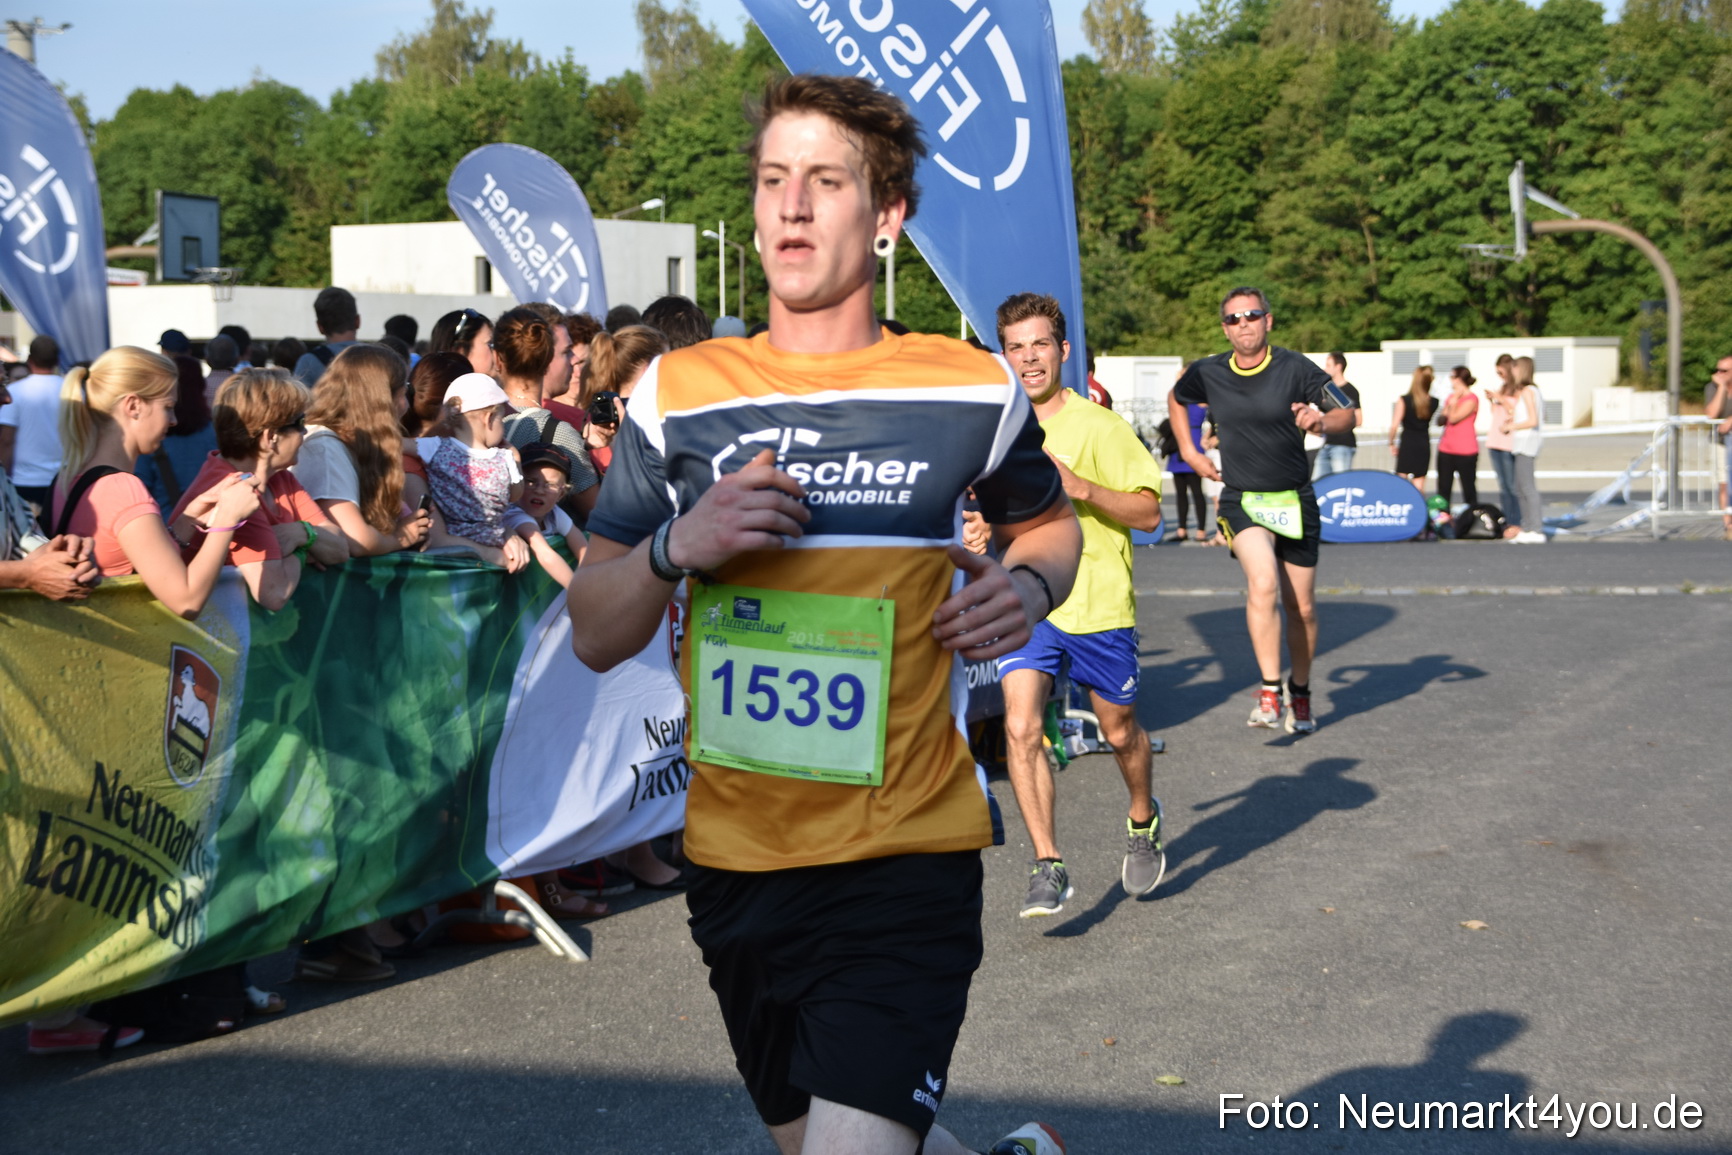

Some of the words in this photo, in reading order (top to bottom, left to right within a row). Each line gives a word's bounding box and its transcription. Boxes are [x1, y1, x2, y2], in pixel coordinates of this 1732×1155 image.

[1331, 499, 1413, 519] Fischer
[1340, 517, 1408, 528] AUTOMOBILE
[721, 611, 788, 635] firmenlauf
[786, 631, 825, 647] 2015
[711, 659, 866, 731] 1539
